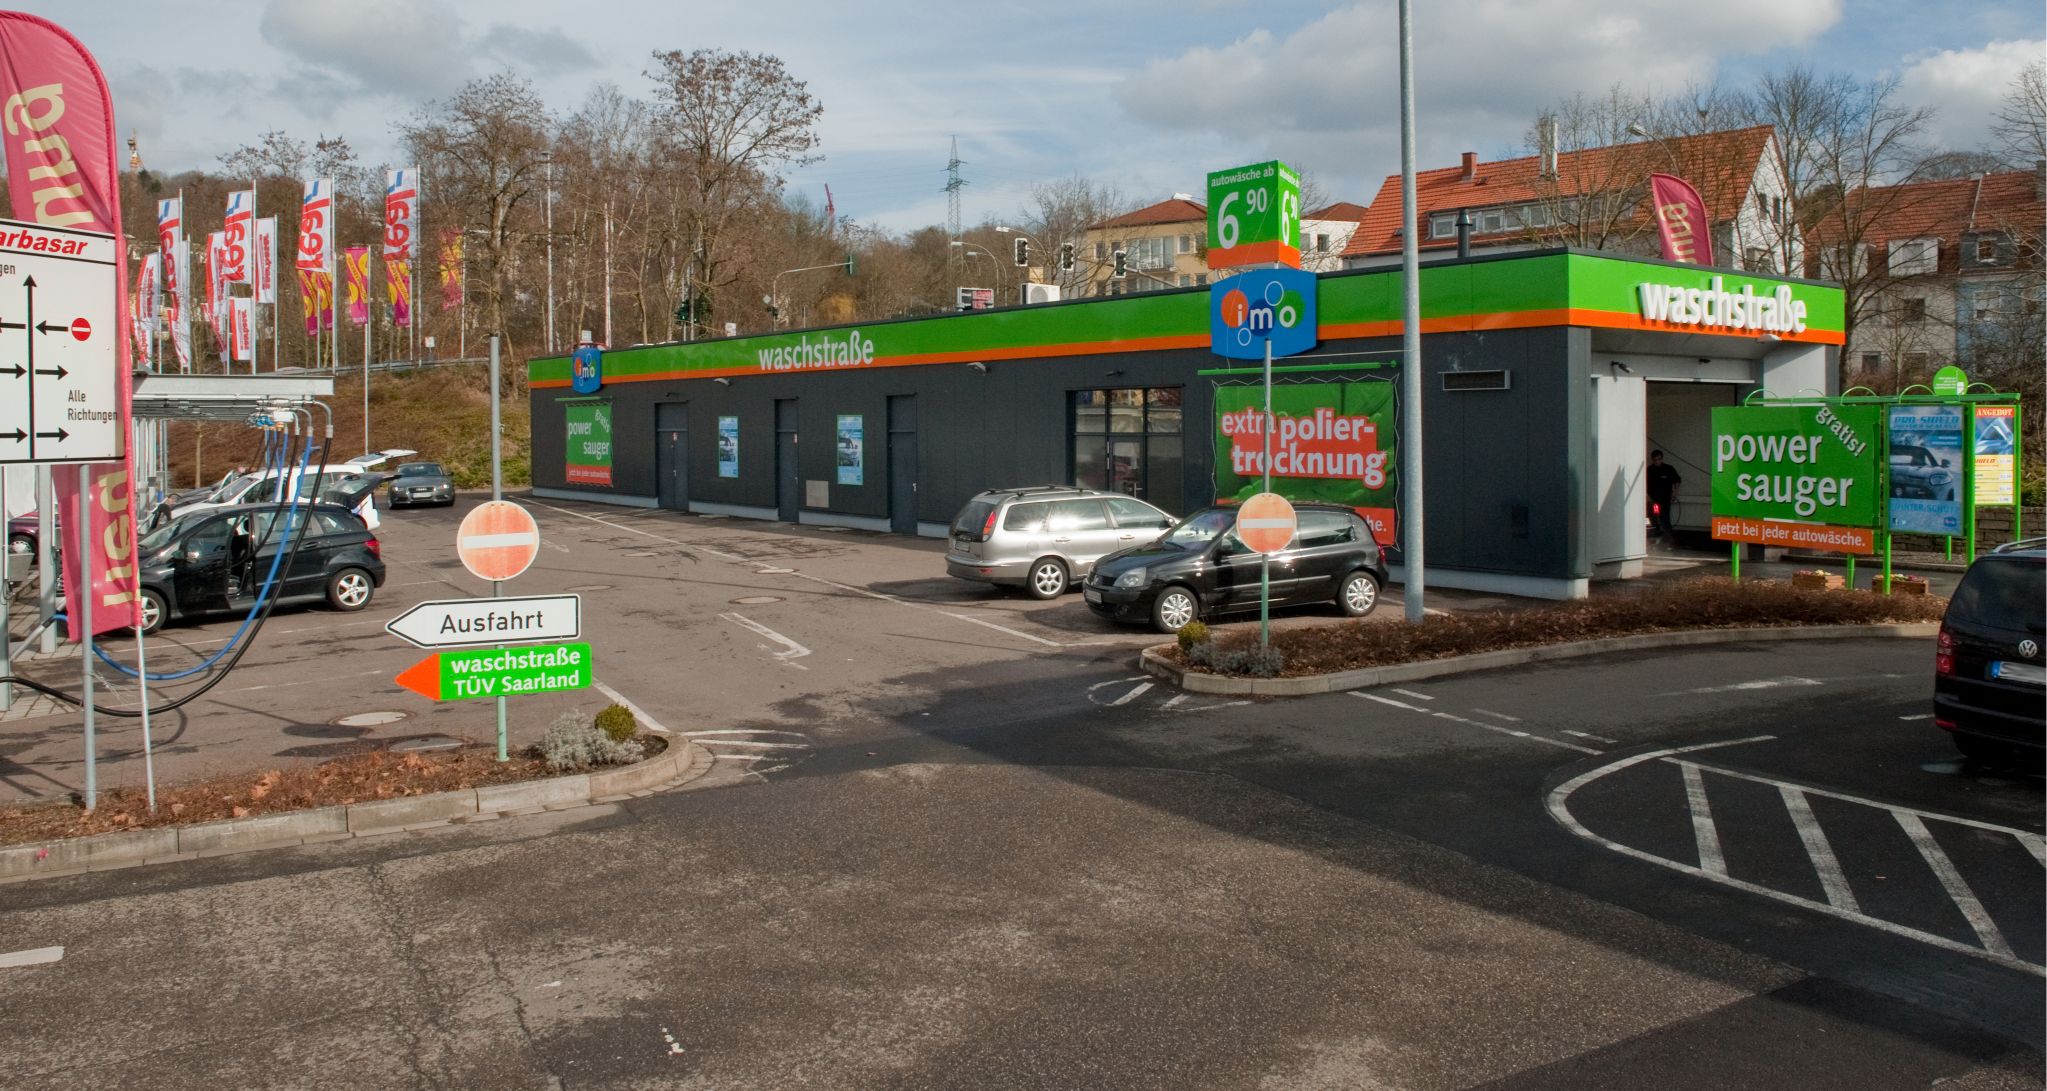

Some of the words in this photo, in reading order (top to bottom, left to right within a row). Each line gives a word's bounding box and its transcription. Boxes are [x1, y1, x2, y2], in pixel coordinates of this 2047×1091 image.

[1211, 169, 1261, 187] autowäsche
[1263, 165, 1274, 177] ab
[1217, 192, 1239, 249] 6
[1246, 187, 1267, 215] 90
[1282, 190, 1290, 246] 6
[1237, 303, 1297, 330] imo
[1639, 276, 1807, 333] waschstraße
[758, 330, 874, 371] waschstraße
[578, 364, 596, 378] imo
[68, 390, 86, 402] Alle
[67, 408, 118, 424] Richtungen
[1976, 408, 2013, 416] ANGEBOT
[568, 421, 592, 440] power
[1280, 408, 1374, 448] polier-
[1815, 406, 1867, 456] gratis!
[583, 441, 609, 460] sauger
[1717, 433, 1823, 472] power
[1232, 443, 1385, 487] trocknung
[1737, 473, 1854, 517] sauger
[1717, 522, 1740, 536] jetzt
[1743, 523, 1758, 536] bei
[1762, 525, 1789, 541] jeder
[1792, 529, 1866, 547] autowäsche.
[440, 610, 543, 634] Ausfahrt
[451, 647, 581, 674] waschstraße
[454, 676, 496, 696] TÜV
[502, 670, 580, 692] Saarland
